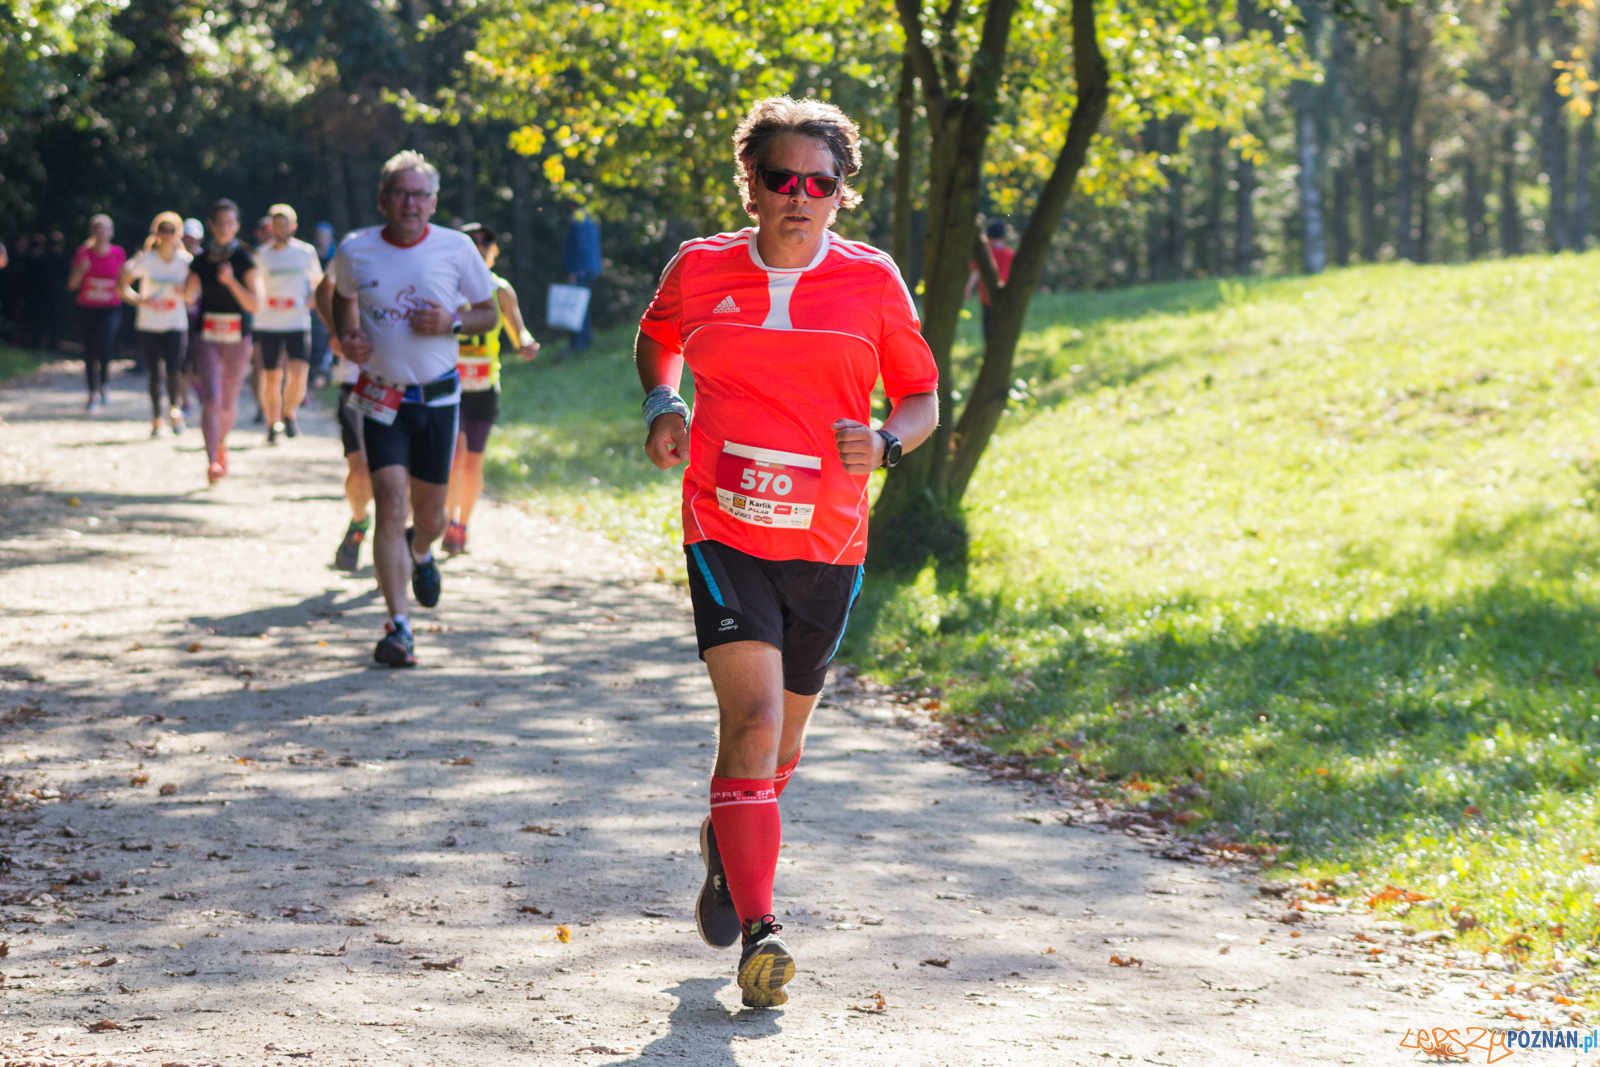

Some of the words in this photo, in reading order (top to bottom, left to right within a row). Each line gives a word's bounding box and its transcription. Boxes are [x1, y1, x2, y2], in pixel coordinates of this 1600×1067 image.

[713, 306, 741, 314] adidas
[740, 468, 793, 496] 570
[749, 500, 772, 510] Karlik
